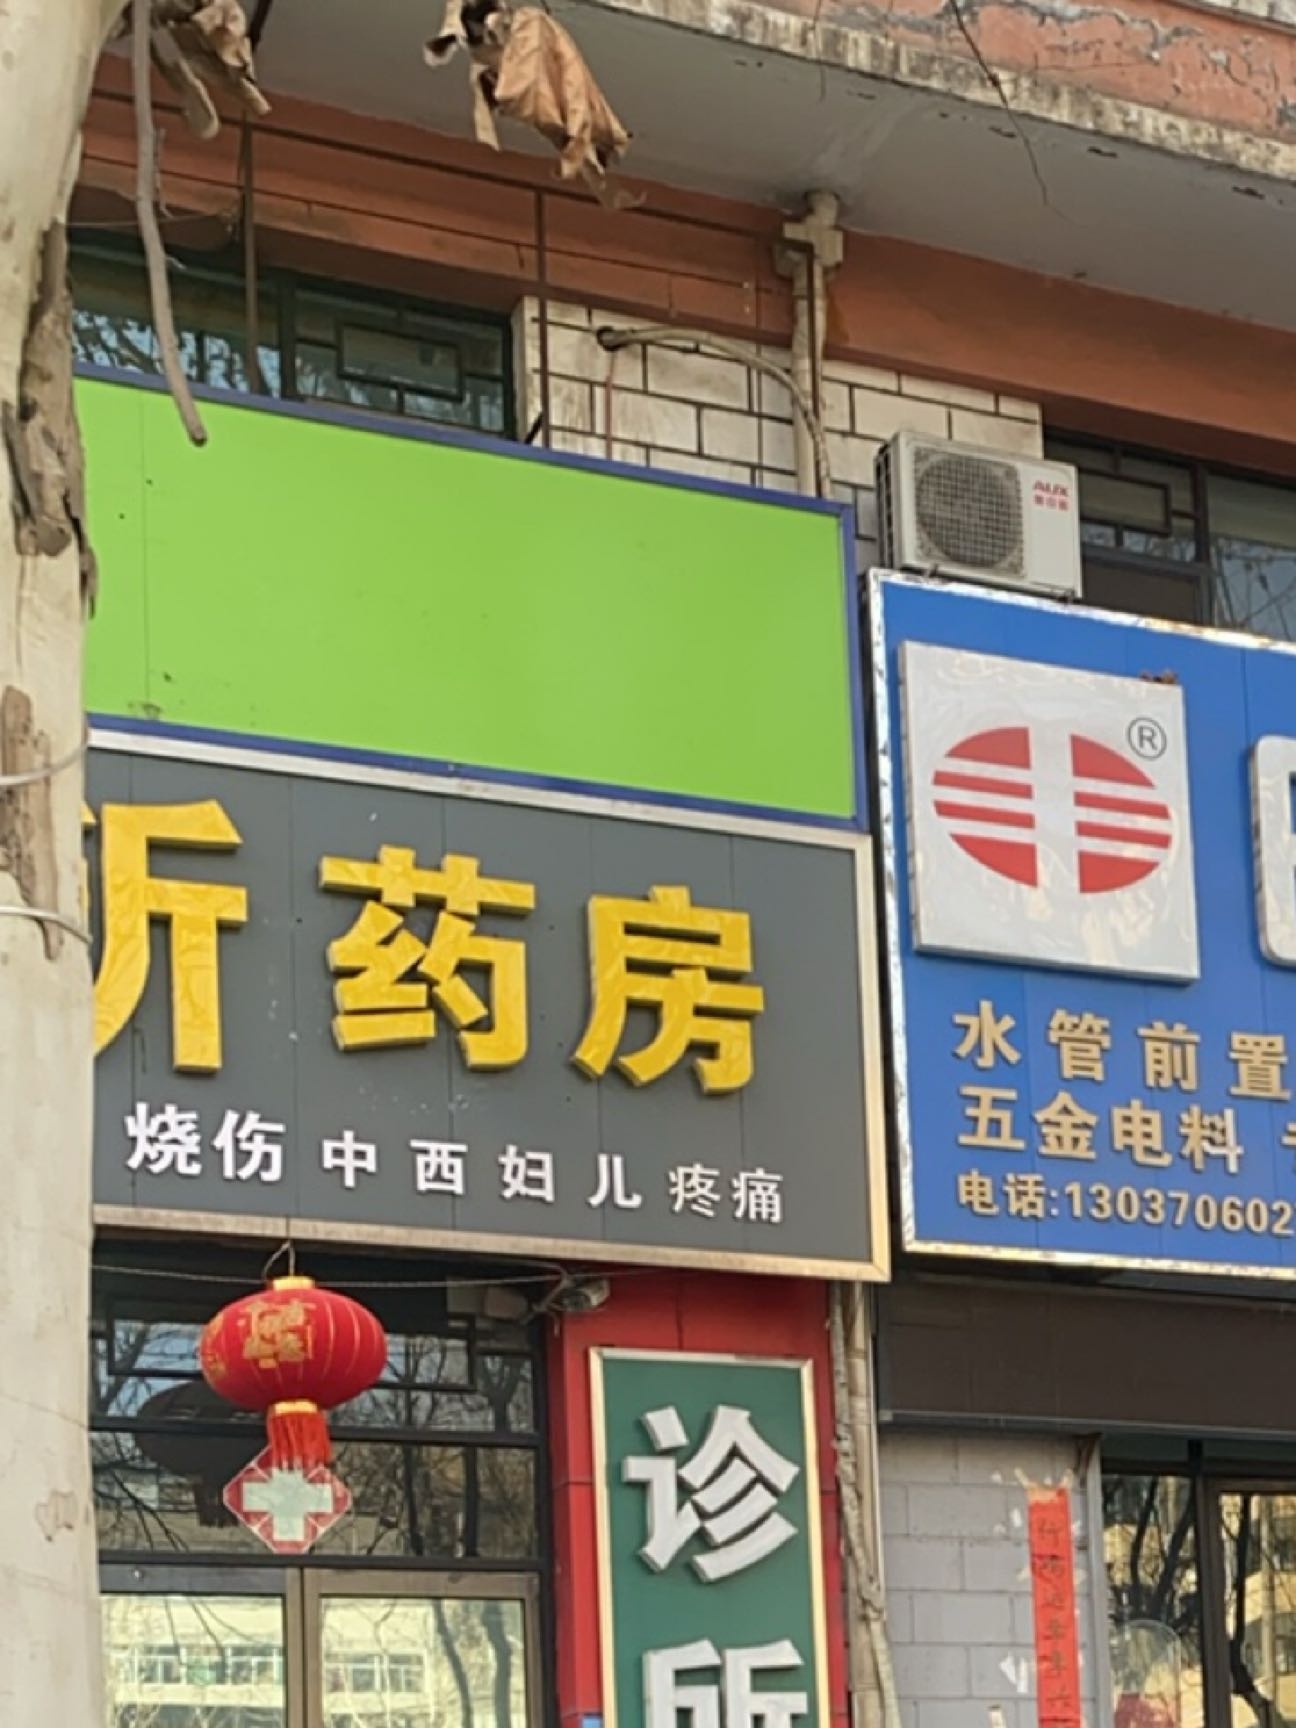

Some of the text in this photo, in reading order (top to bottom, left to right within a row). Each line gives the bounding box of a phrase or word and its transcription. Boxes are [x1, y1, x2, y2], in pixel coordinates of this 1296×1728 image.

[124, 1102, 287, 1183] 烧伤
[668, 1162, 785, 1224] 疼痛
[957, 1084, 1245, 1174] 五金电料
